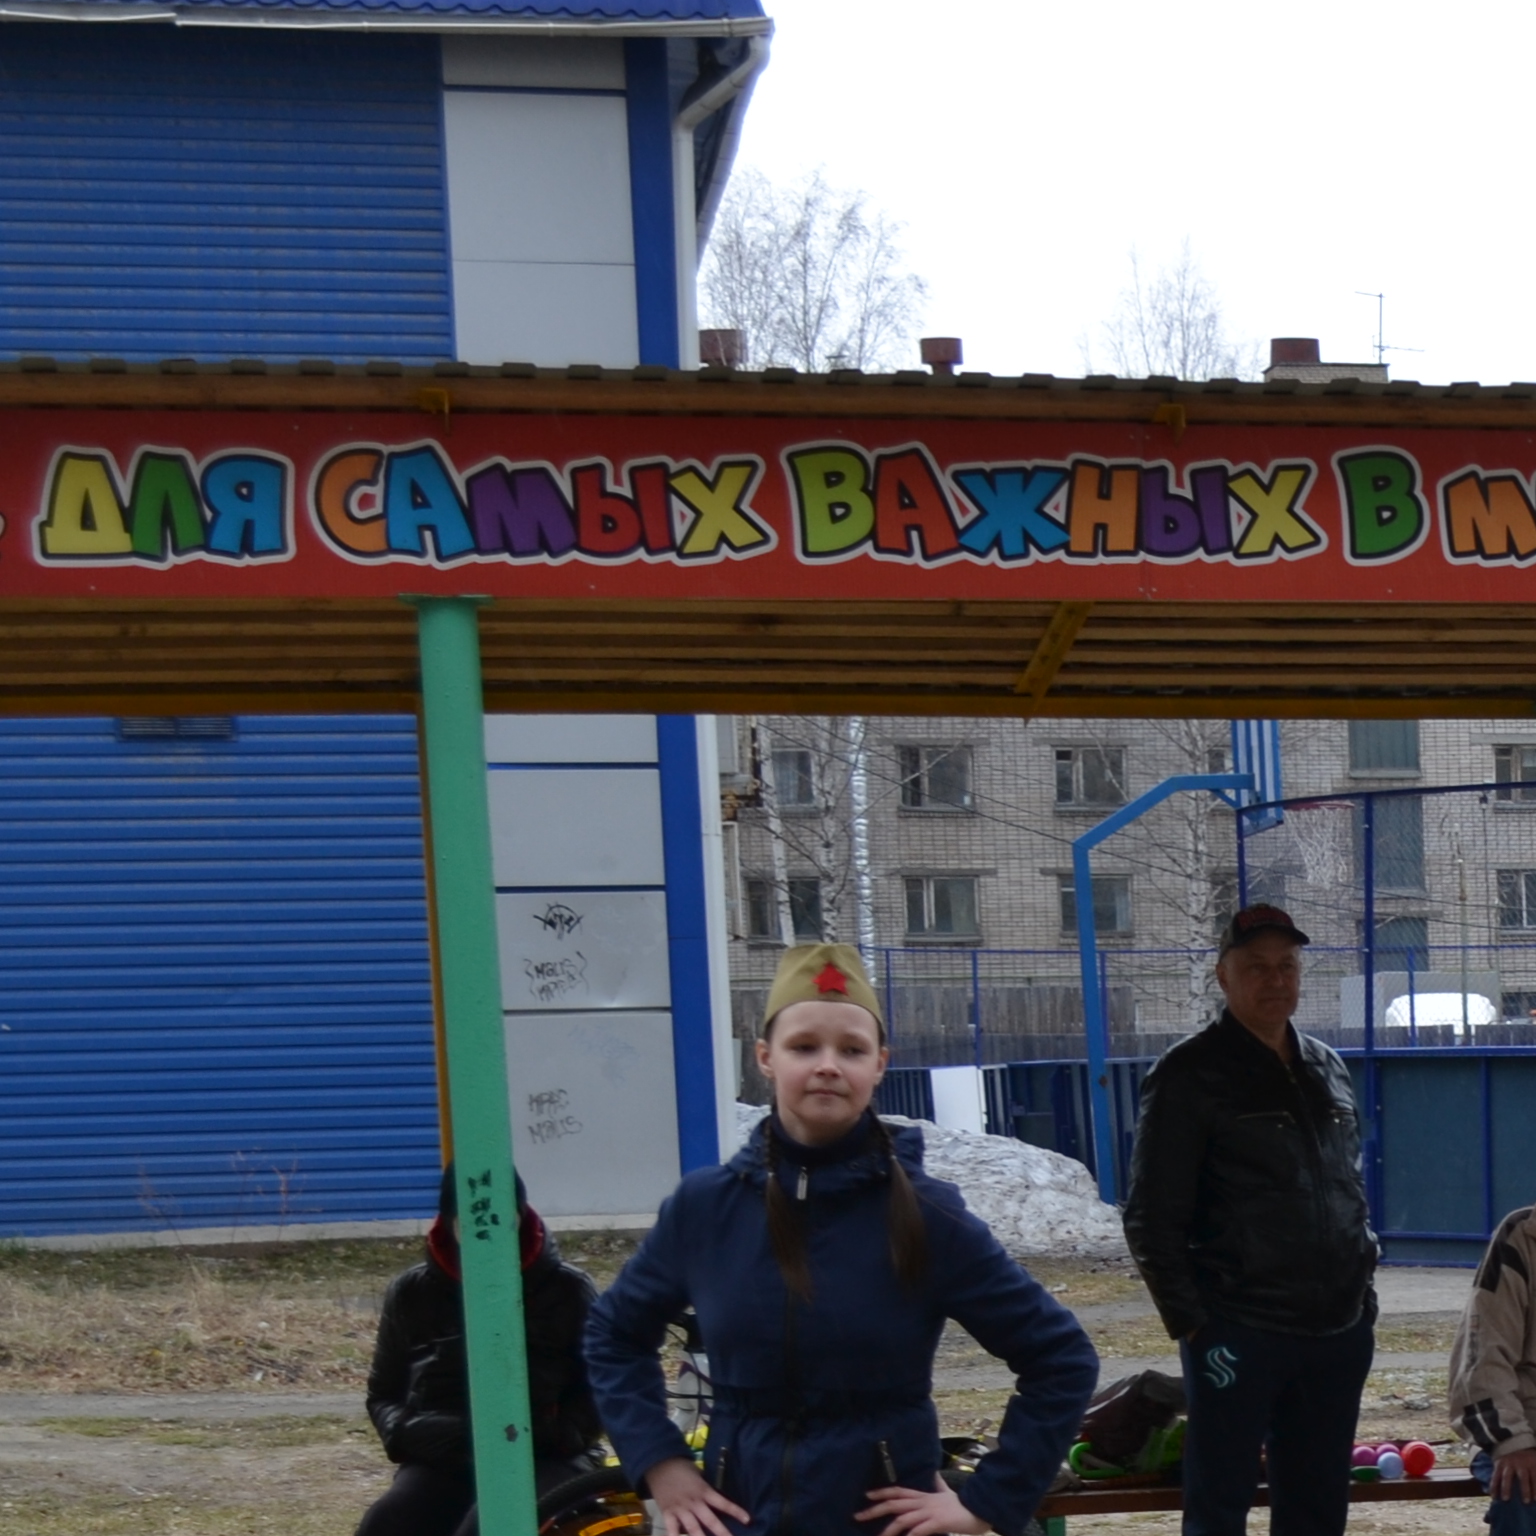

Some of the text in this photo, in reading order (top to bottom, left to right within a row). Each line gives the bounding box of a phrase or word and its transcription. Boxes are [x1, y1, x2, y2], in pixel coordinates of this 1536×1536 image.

[36, 448, 293, 568] ДЛЯ
[317, 441, 776, 568] САМЫХ
[787, 440, 1325, 567] ВАЖНЫХ
[1340, 447, 1427, 568] В
